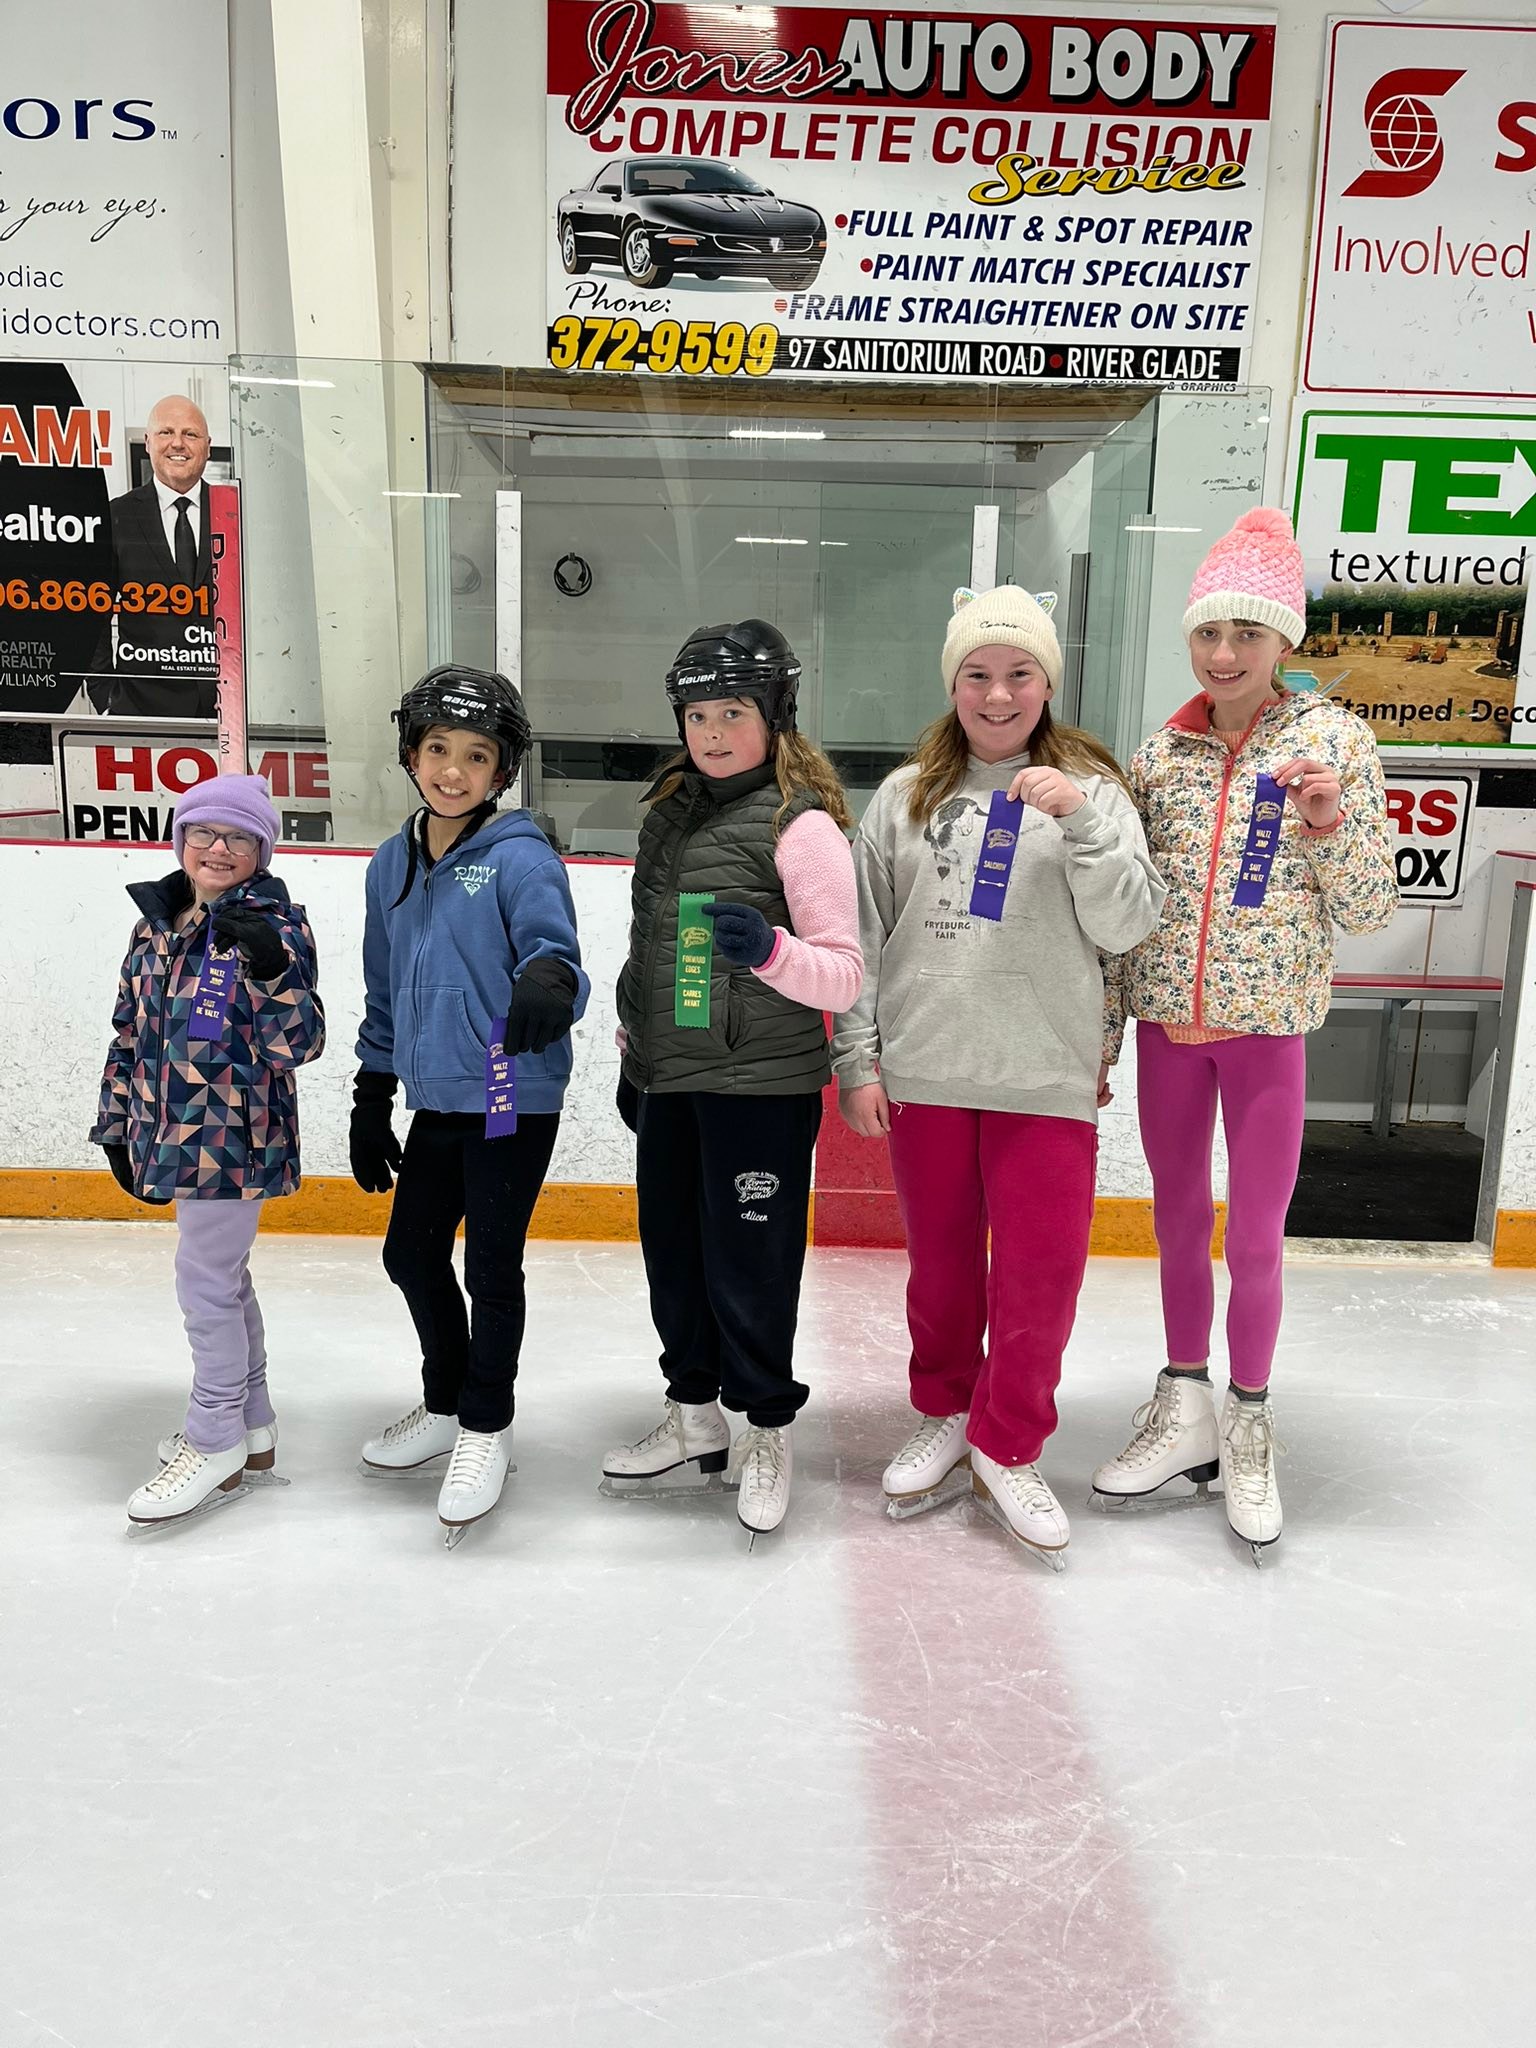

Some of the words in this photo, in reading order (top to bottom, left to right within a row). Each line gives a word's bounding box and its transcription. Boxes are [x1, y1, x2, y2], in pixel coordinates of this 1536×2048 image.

[566, 0, 846, 135] Jones
[837, 18, 1029, 97] AUTO
[1049, 26, 1250, 103] BODY
[2, 98, 157, 141] ors
[590, 106, 916, 163] COMPLETE
[931, 117, 1253, 171] COLLISION
[968, 152, 1247, 206] Service
[0, 198, 90, 242] your
[90, 198, 166, 243] eyes.
[847, 210, 915, 239] FULL
[924, 212, 1016, 241] PAINT
[1023, 215, 1046, 242] &
[1055, 216, 1137, 245] SPOT
[1142, 219, 1254, 247] REPAIR
[1334, 225, 1532, 279] Involved
[0, 265, 64, 288] diac
[872, 254, 964, 283] PAINT
[969, 257, 1084, 286] MATCH
[1084, 259, 1251, 289] SPECIALIST
[566, 280, 672, 314] Phone:
[788, 294, 892, 323] FRAME
[899, 297, 1122, 328] STRAIGHTENER
[1131, 303, 1177, 330] ON
[1185, 304, 1250, 332] SITE
[2, 308, 220, 340] idoctors.com
[788, 338, 818, 369] 97
[824, 339, 972, 375] SANITORIUM
[979, 344, 1046, 377] ROAD
[1066, 347, 1135, 378] RIVER
[1142, 348, 1222, 380] GLADE
[1181, 382, 1237, 392] GRAPHICS
[0, 505, 101, 543] altor
[1329, 546, 1526, 587] textured
[0, 579, 209, 615] 6.866.3291
[0, 641, 56, 656] CAPITAL
[2, 656, 54, 669] REALTY
[73, 804, 175, 842] PEN
[454, 865, 496, 884] ROXY
[924, 920, 971, 930] FRYEBURG
[935, 931, 957, 940] FAIR
